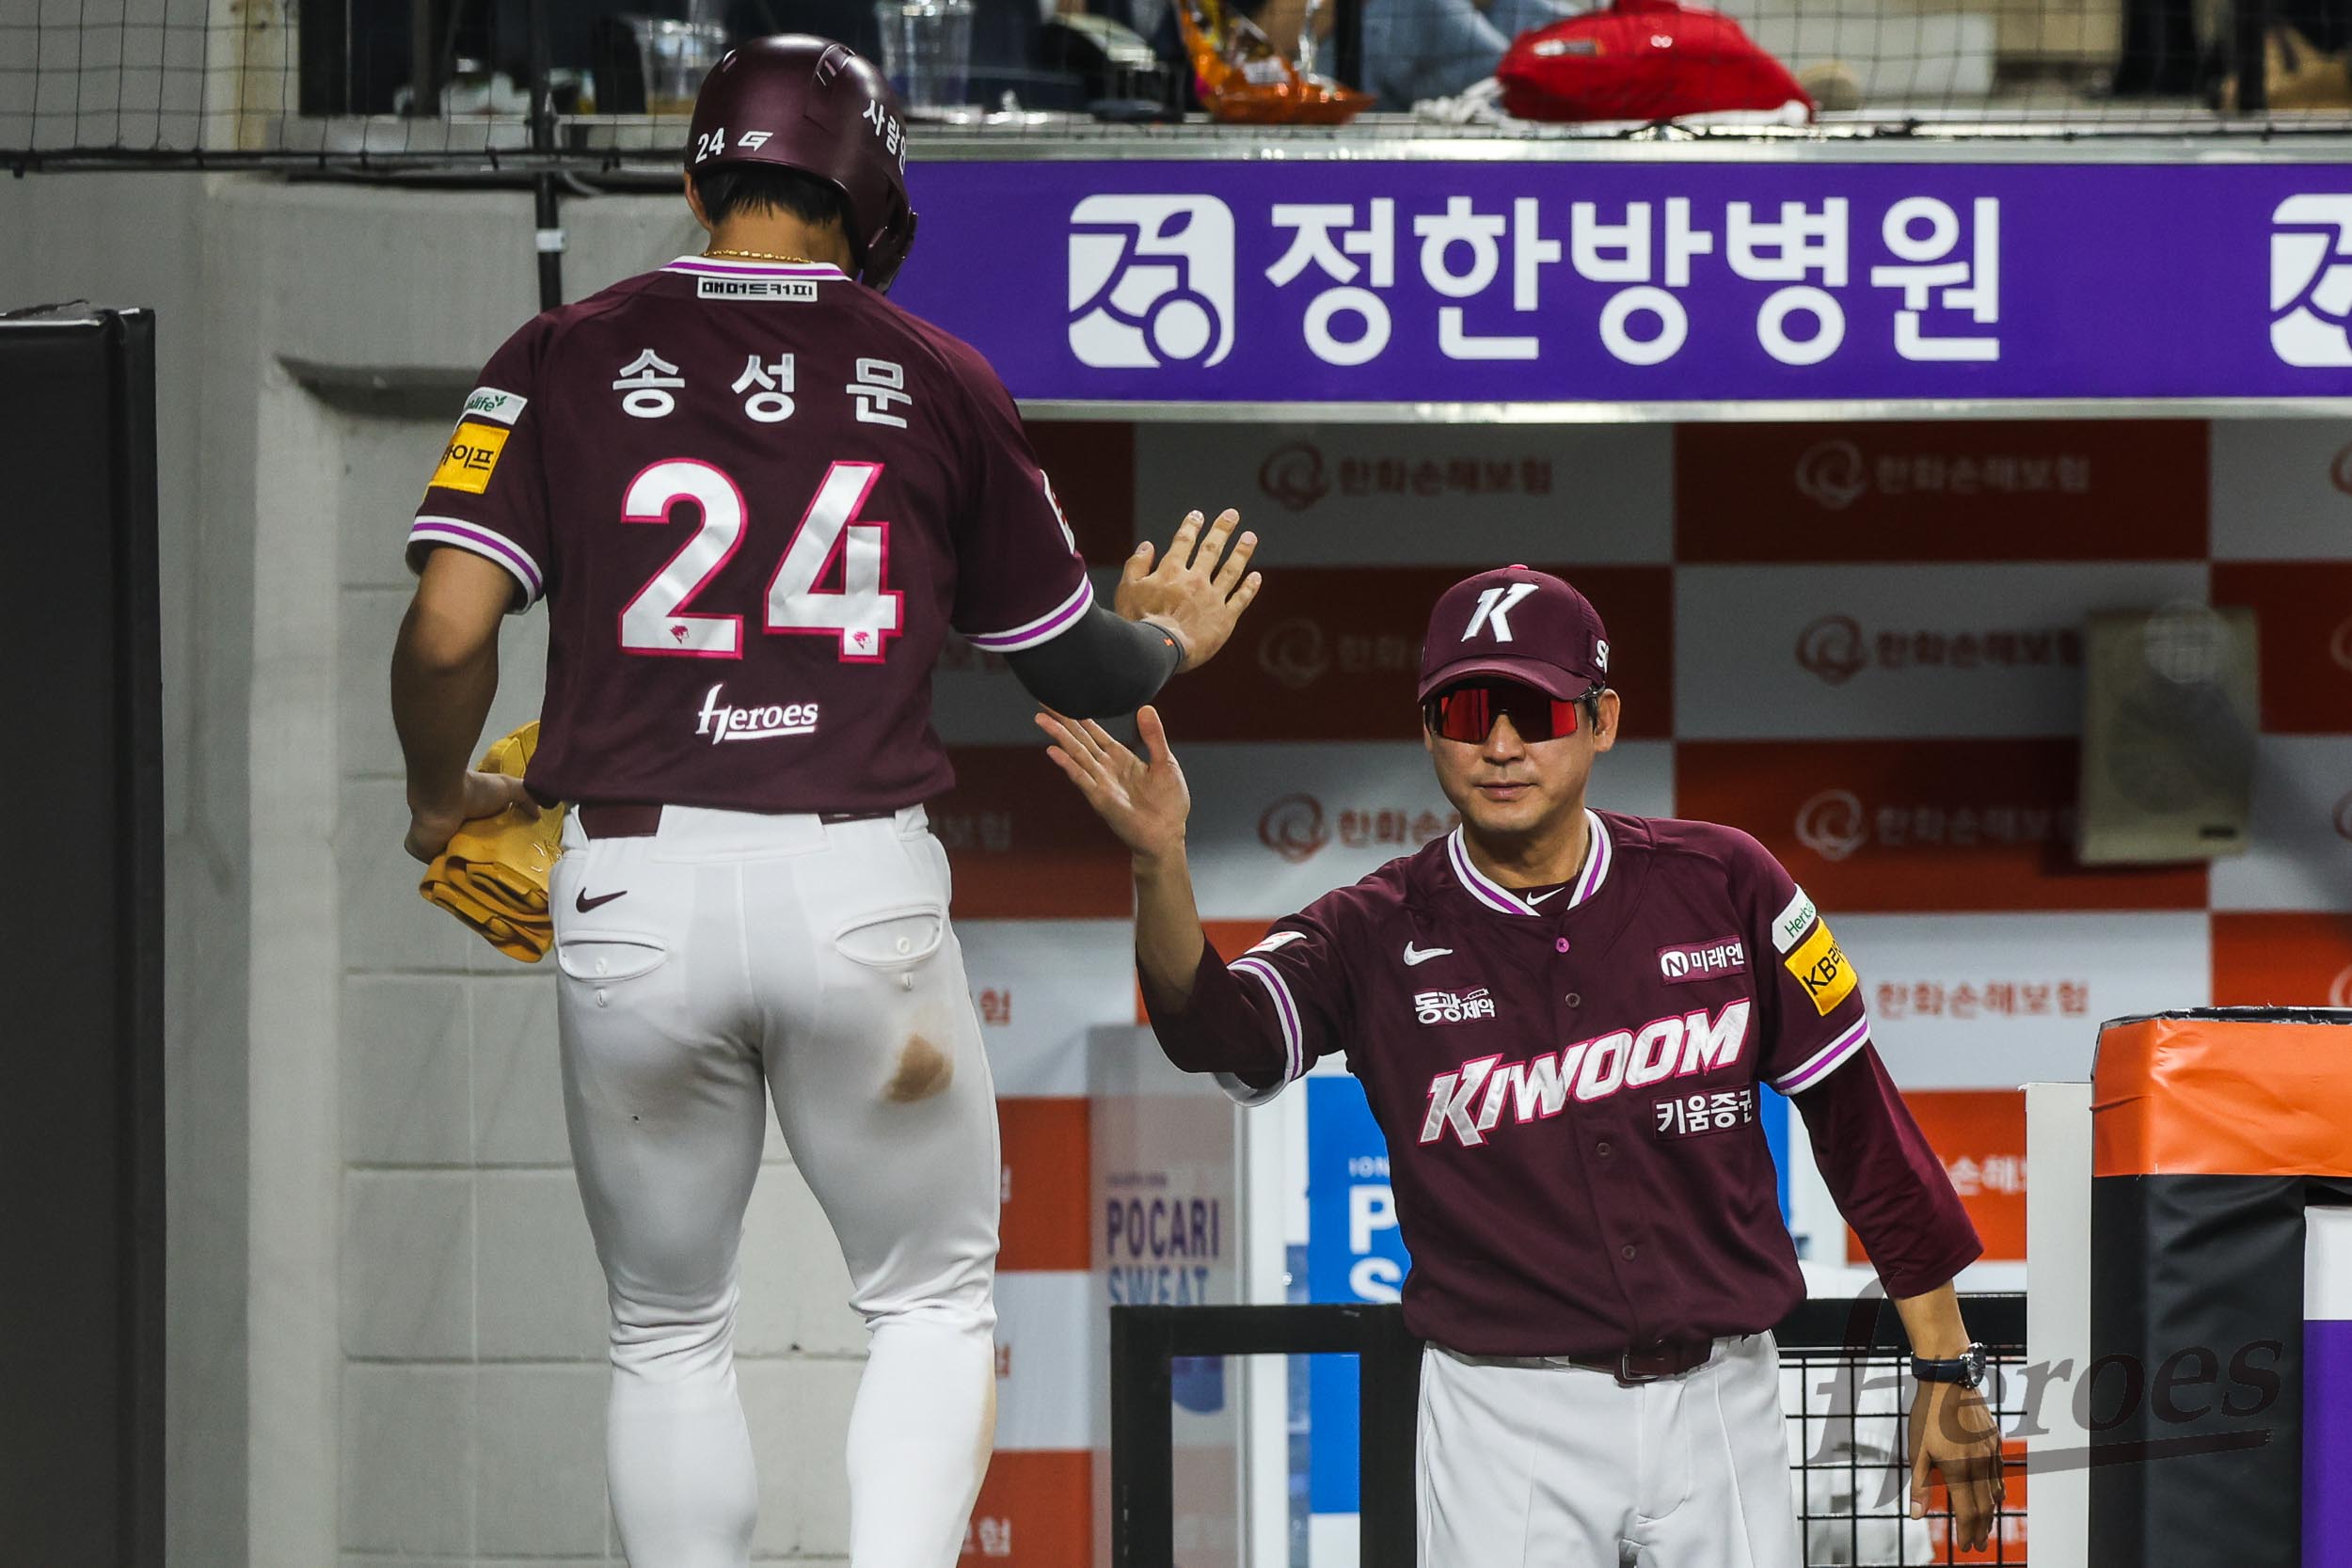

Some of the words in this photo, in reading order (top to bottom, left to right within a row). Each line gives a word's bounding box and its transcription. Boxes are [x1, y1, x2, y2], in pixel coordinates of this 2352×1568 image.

[694, 127, 725, 164] 24
[702, 281, 813, 296] 매머드커피
[1264, 196, 2000, 366] 정한방병원
[617, 456, 904, 664] 24
[1460, 582, 1540, 642] K
[1690, 942, 1745, 973] 미래엔
[1414, 991, 1496, 1024] 동광제약
[1418, 997, 1751, 1149] KIWOOM
[1106, 1197, 1219, 1259] POCARI
